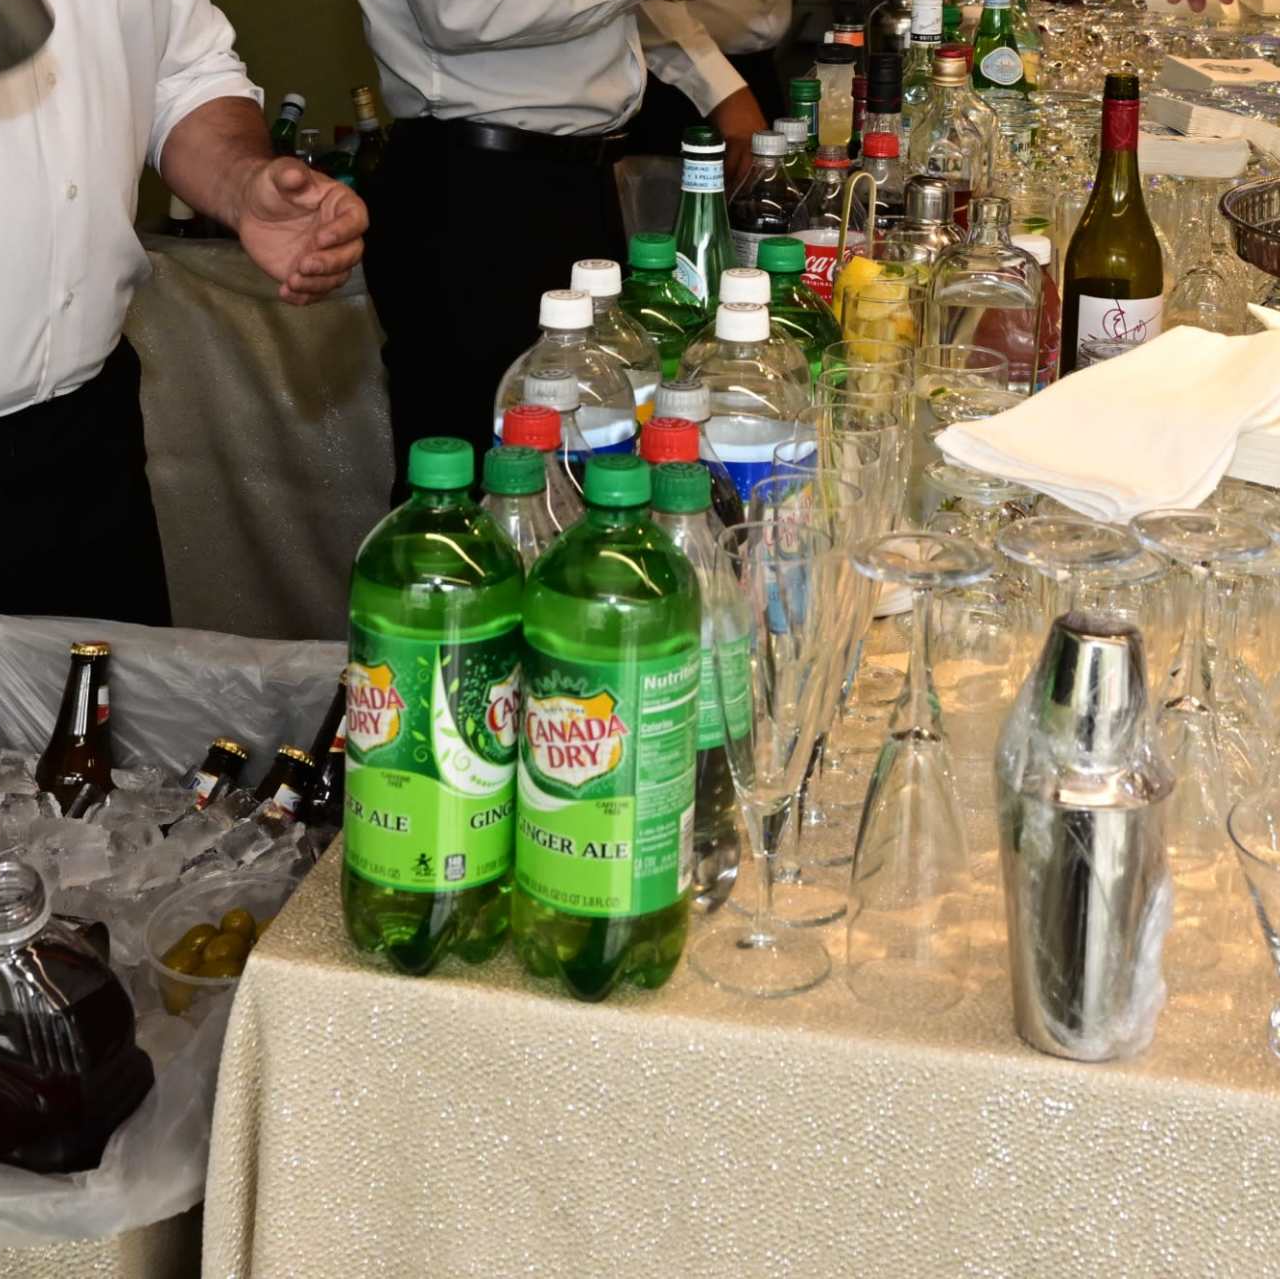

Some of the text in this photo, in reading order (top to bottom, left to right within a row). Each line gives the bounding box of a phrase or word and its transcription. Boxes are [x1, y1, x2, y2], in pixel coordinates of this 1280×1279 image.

[348, 708, 382, 735] DRY
[526, 710, 628, 749] CANADA
[546, 741, 601, 769] DRY
[368, 810, 409, 832] ALE
[581, 842, 628, 859] ALE
